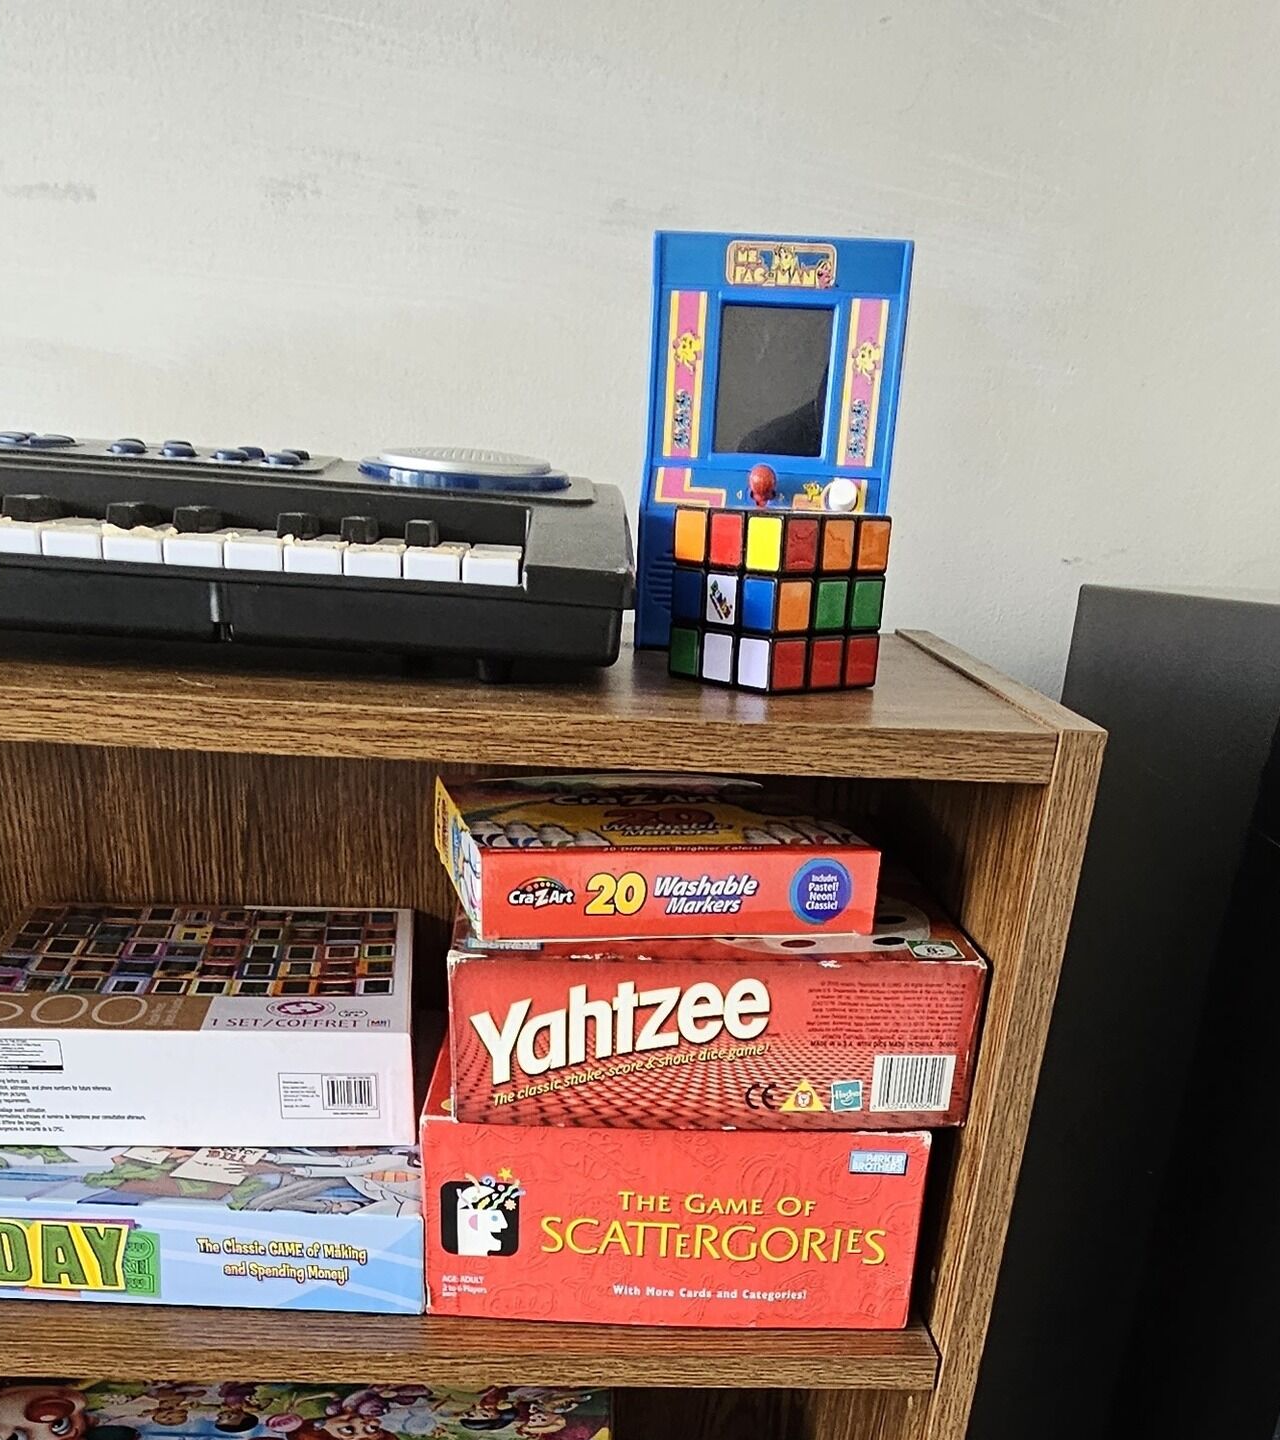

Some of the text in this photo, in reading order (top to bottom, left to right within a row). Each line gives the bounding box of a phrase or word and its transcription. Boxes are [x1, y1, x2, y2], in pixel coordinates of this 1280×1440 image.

[585, 871, 648, 916] 20
[654, 873, 759, 897] Washable
[809, 891, 837, 901] Neon!
[665, 897, 743, 915] Markers
[805, 900, 839, 911] Classic!
[224, 1018, 361, 1028] SET/COFFRET
[470, 978, 771, 1086] Yahtzee
[492, 1092, 516, 1107] The
[517, 1079, 562, 1101] classic
[563, 1067, 606, 1087] shake,
[608, 1060, 643, 1078] score
[656, 1053, 696, 1068] shout
[697, 1048, 725, 1062] dice
[196, 1237, 368, 1265] The Classic GAME of Making
[540, 1216, 887, 1266] SCATTERGORIES
[223, 1261, 350, 1286] and Spending Money!
[613, 1284, 808, 1302] With More Cards and Categories!
